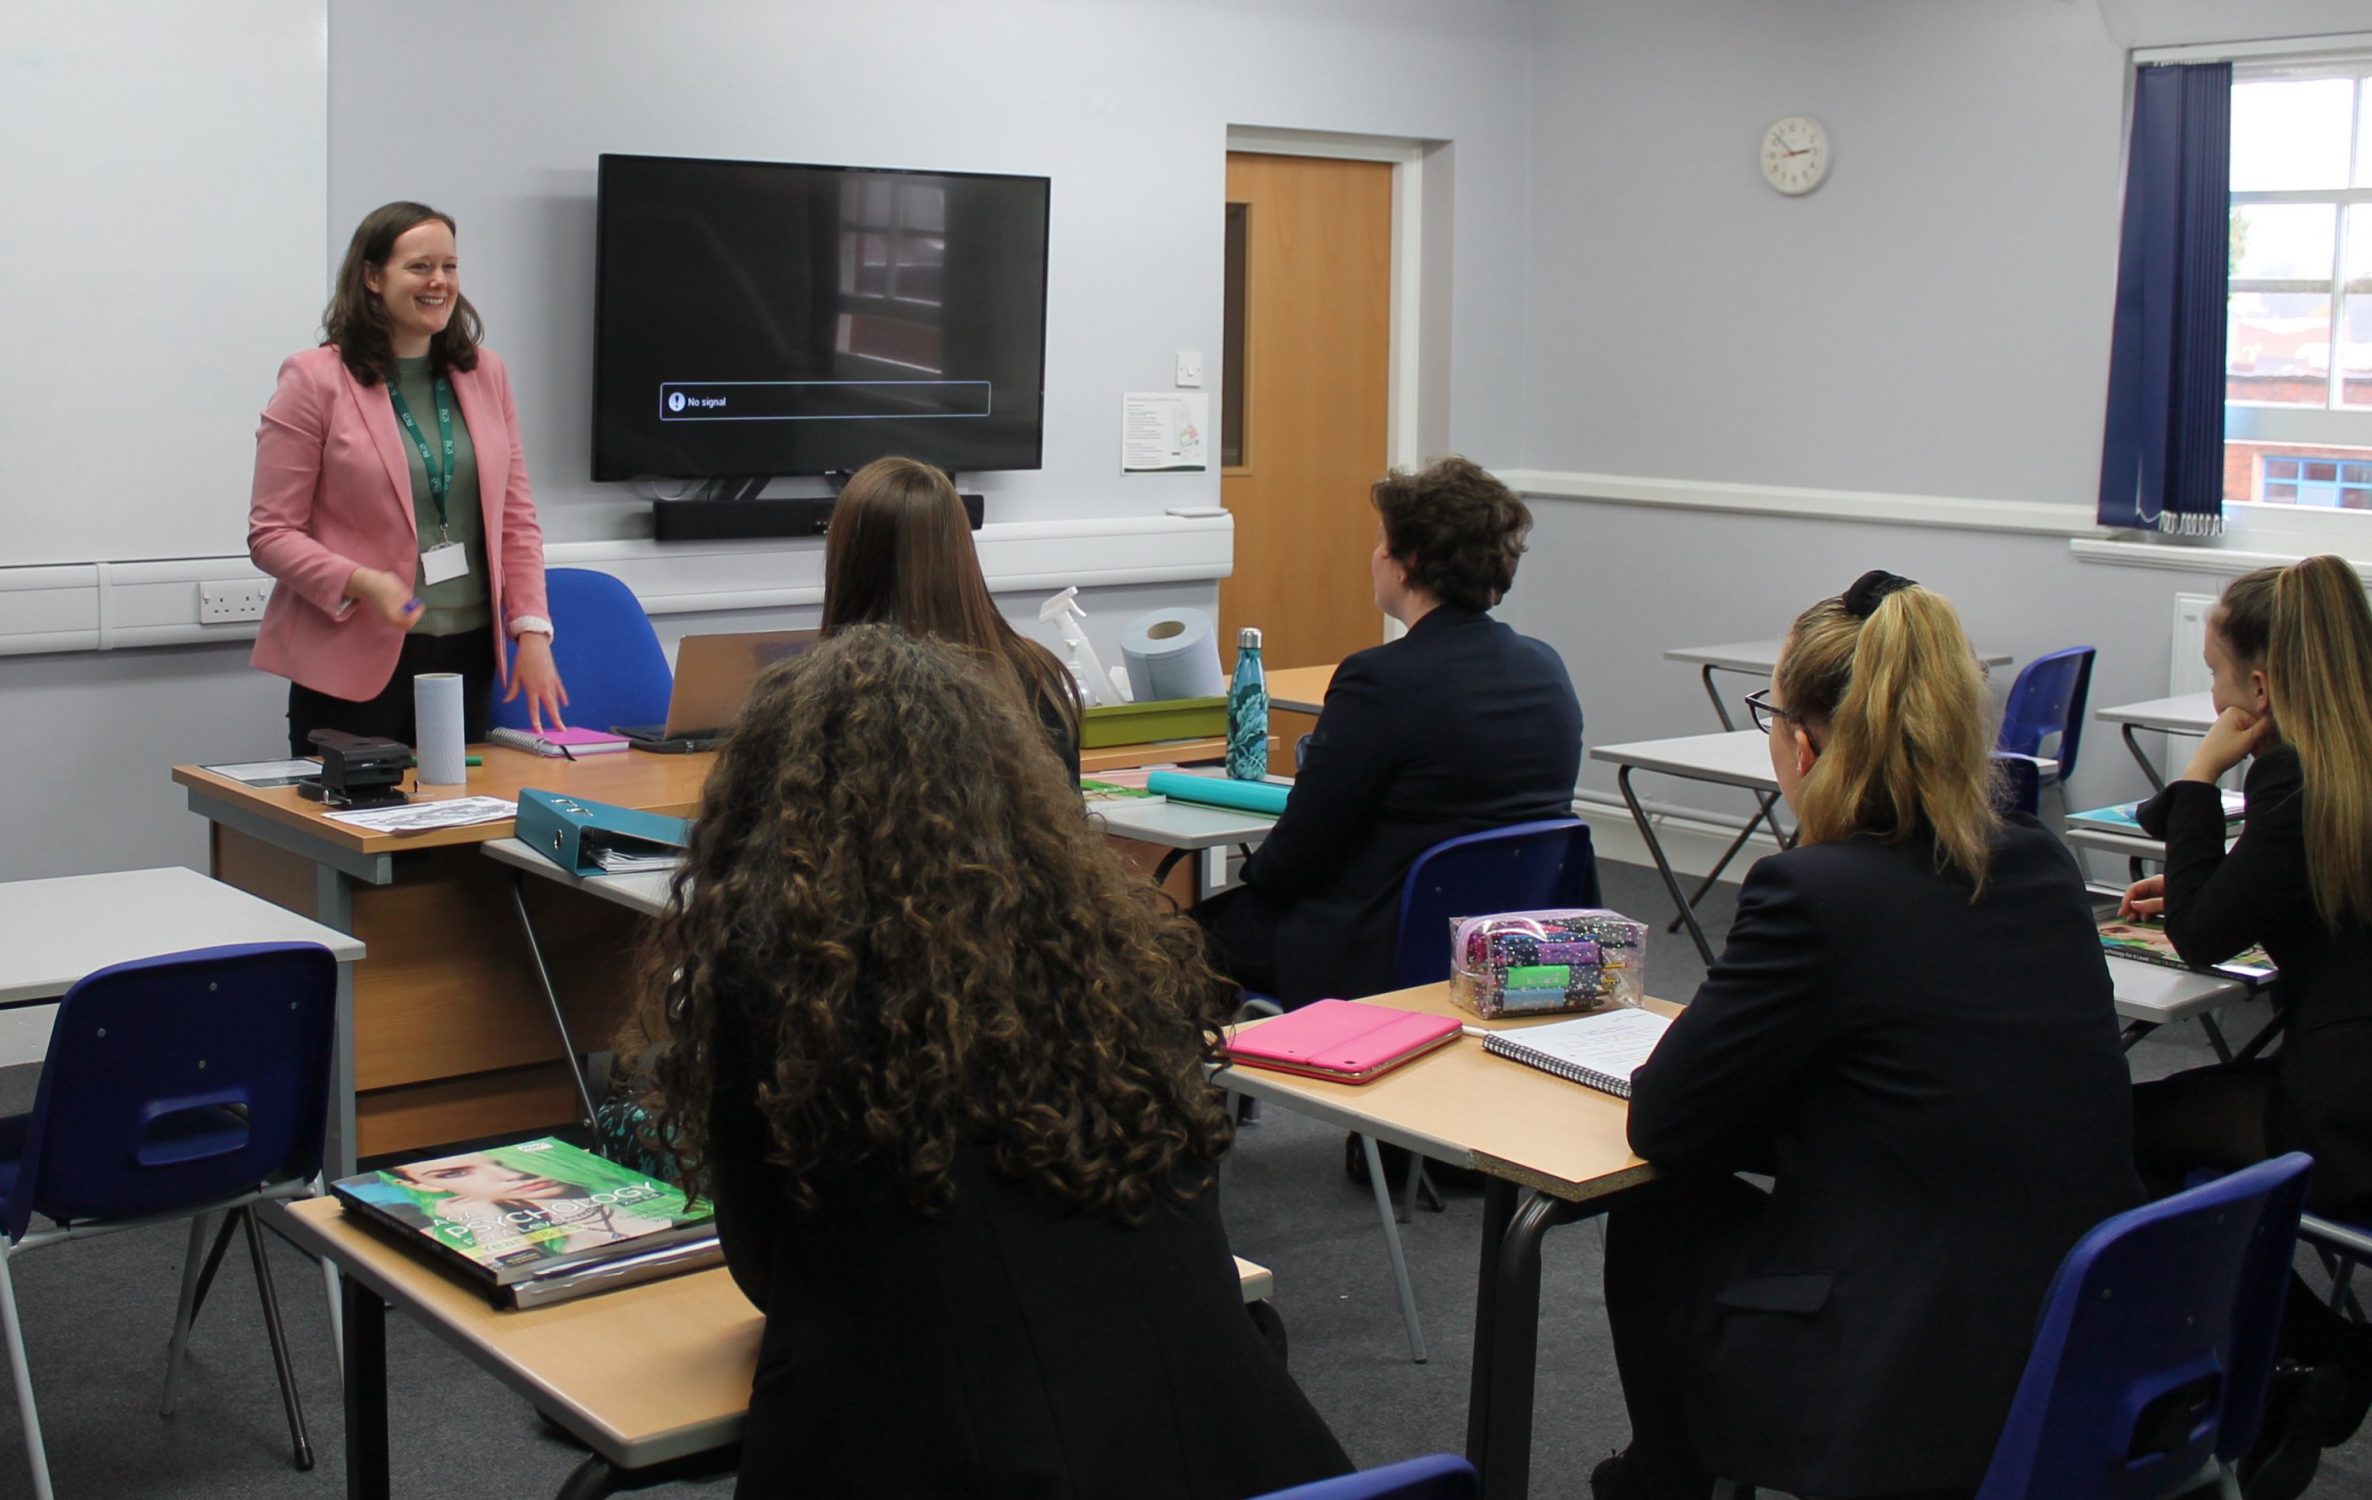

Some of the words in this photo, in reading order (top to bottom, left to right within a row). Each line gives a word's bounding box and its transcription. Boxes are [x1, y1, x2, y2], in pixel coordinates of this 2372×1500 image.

[688, 397, 700, 407] No
[701, 396, 726, 409] signal
[444, 1181, 656, 1238] PSYCHOLOGY
